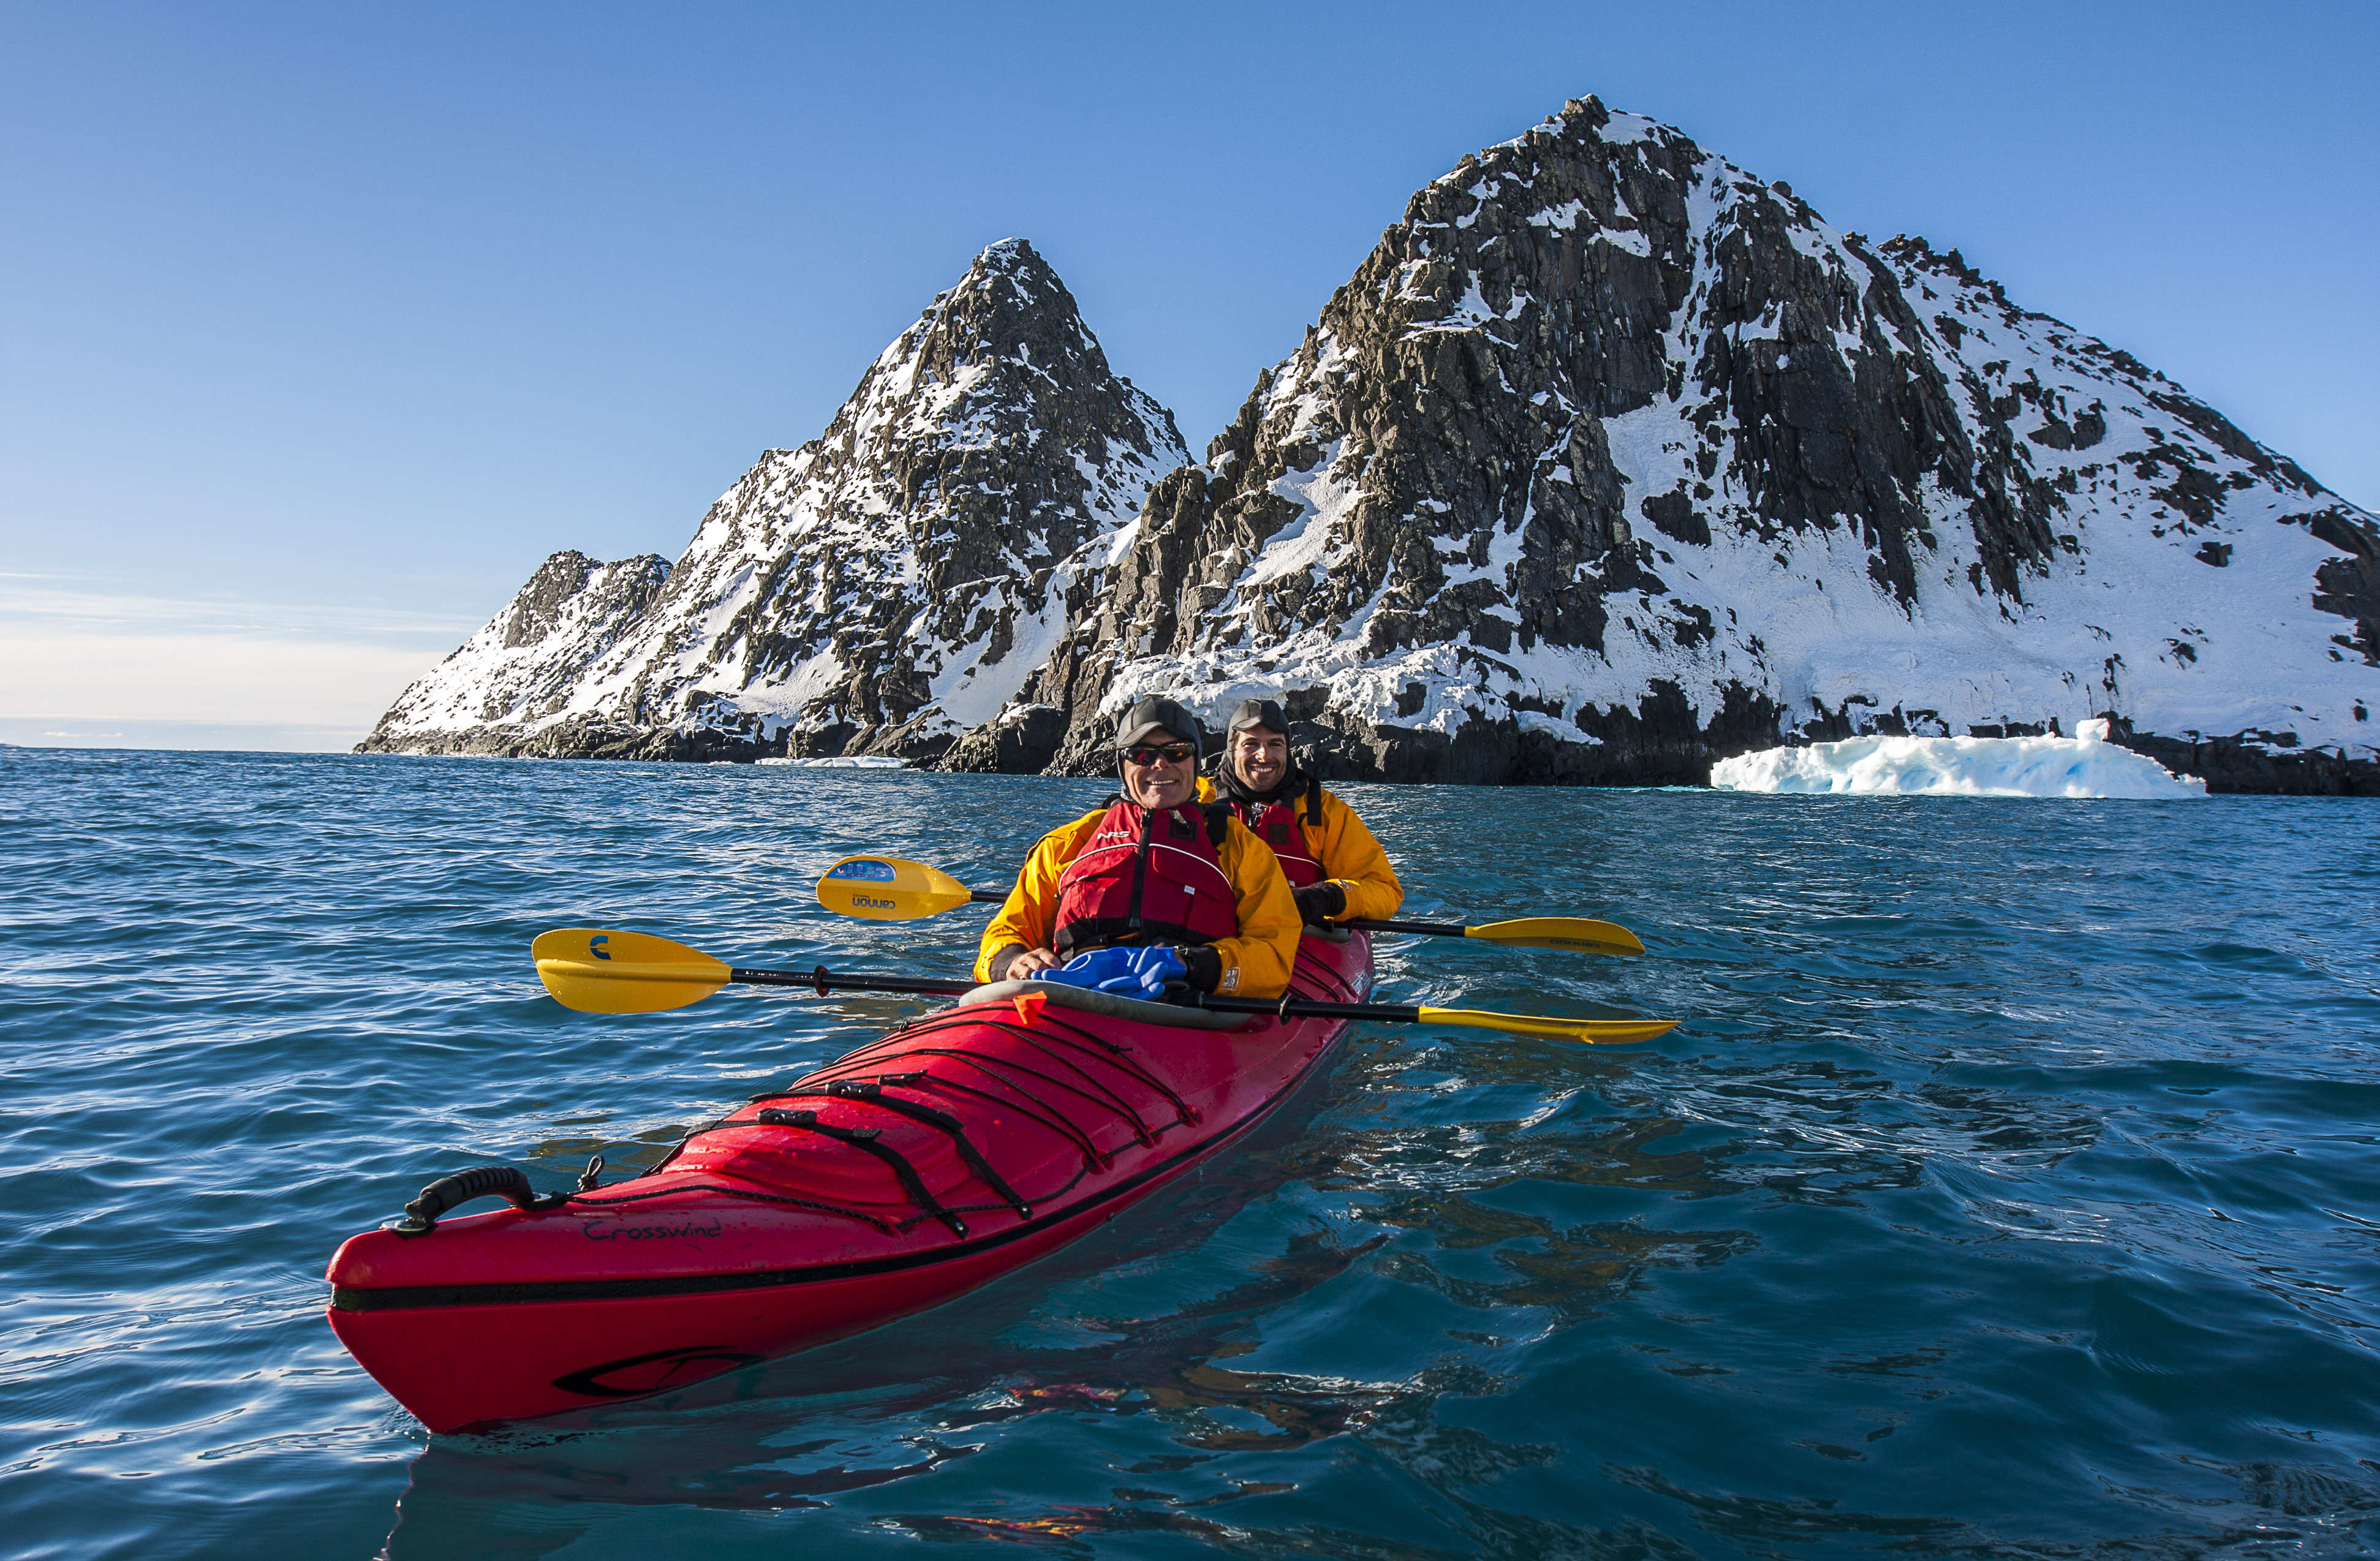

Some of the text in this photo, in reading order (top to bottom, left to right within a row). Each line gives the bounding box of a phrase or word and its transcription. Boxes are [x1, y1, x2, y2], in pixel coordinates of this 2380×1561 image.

[1097, 831, 1131, 840] NRS
[852, 898, 896, 909] cannon
[583, 1217, 722, 1241] Crosswind
